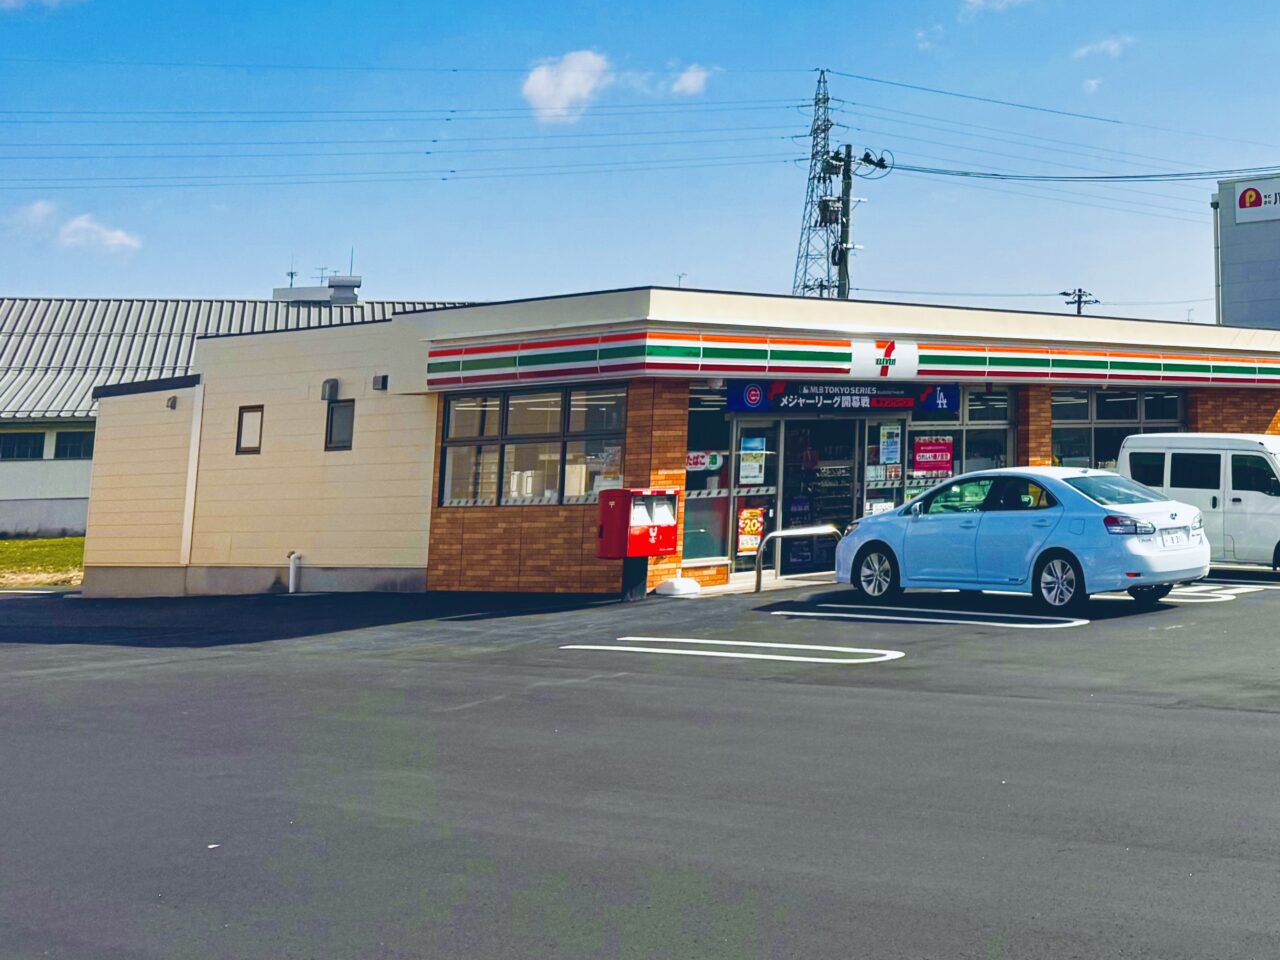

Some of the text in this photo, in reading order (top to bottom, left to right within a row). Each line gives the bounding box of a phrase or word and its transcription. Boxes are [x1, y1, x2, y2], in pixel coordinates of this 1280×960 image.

[825, 386, 850, 394] TOKYO
[850, 386, 877, 395] SERIES
[780, 395, 871, 408] メジャーリーグ開幕戦
[686, 454, 706, 466] たばこ
[744, 519, 758, 531] 20
